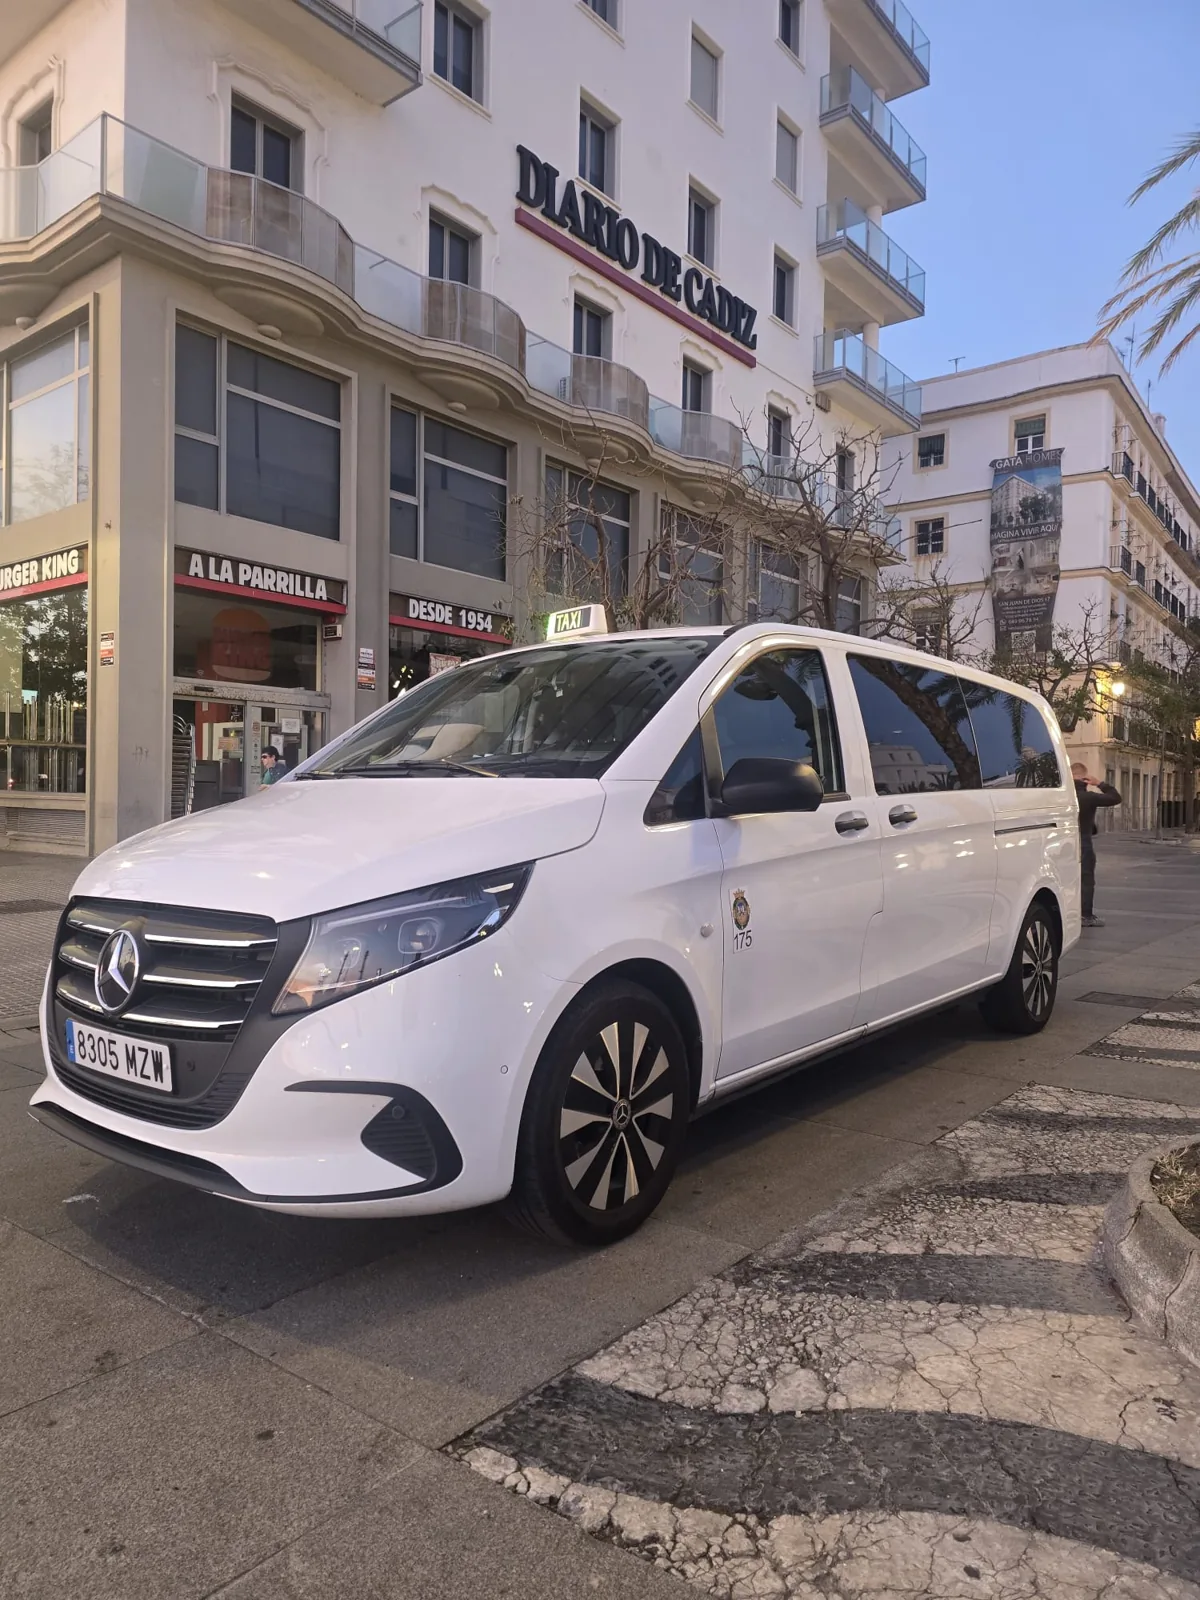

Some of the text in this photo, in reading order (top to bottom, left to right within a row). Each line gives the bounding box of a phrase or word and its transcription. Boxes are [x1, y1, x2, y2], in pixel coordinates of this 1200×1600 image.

[515, 144, 758, 350] DIARIO DE CADIZ
[1020, 527, 1040, 536] VIVIR
[42, 549, 79, 581] KING
[188, 553, 328, 600] A LA PARRILLA
[409, 598, 493, 632] DESDE 1954
[556, 609, 582, 632] TAXI
[733, 929, 753, 950] 175
[77, 1029, 164, 1084] 8305 MZW
